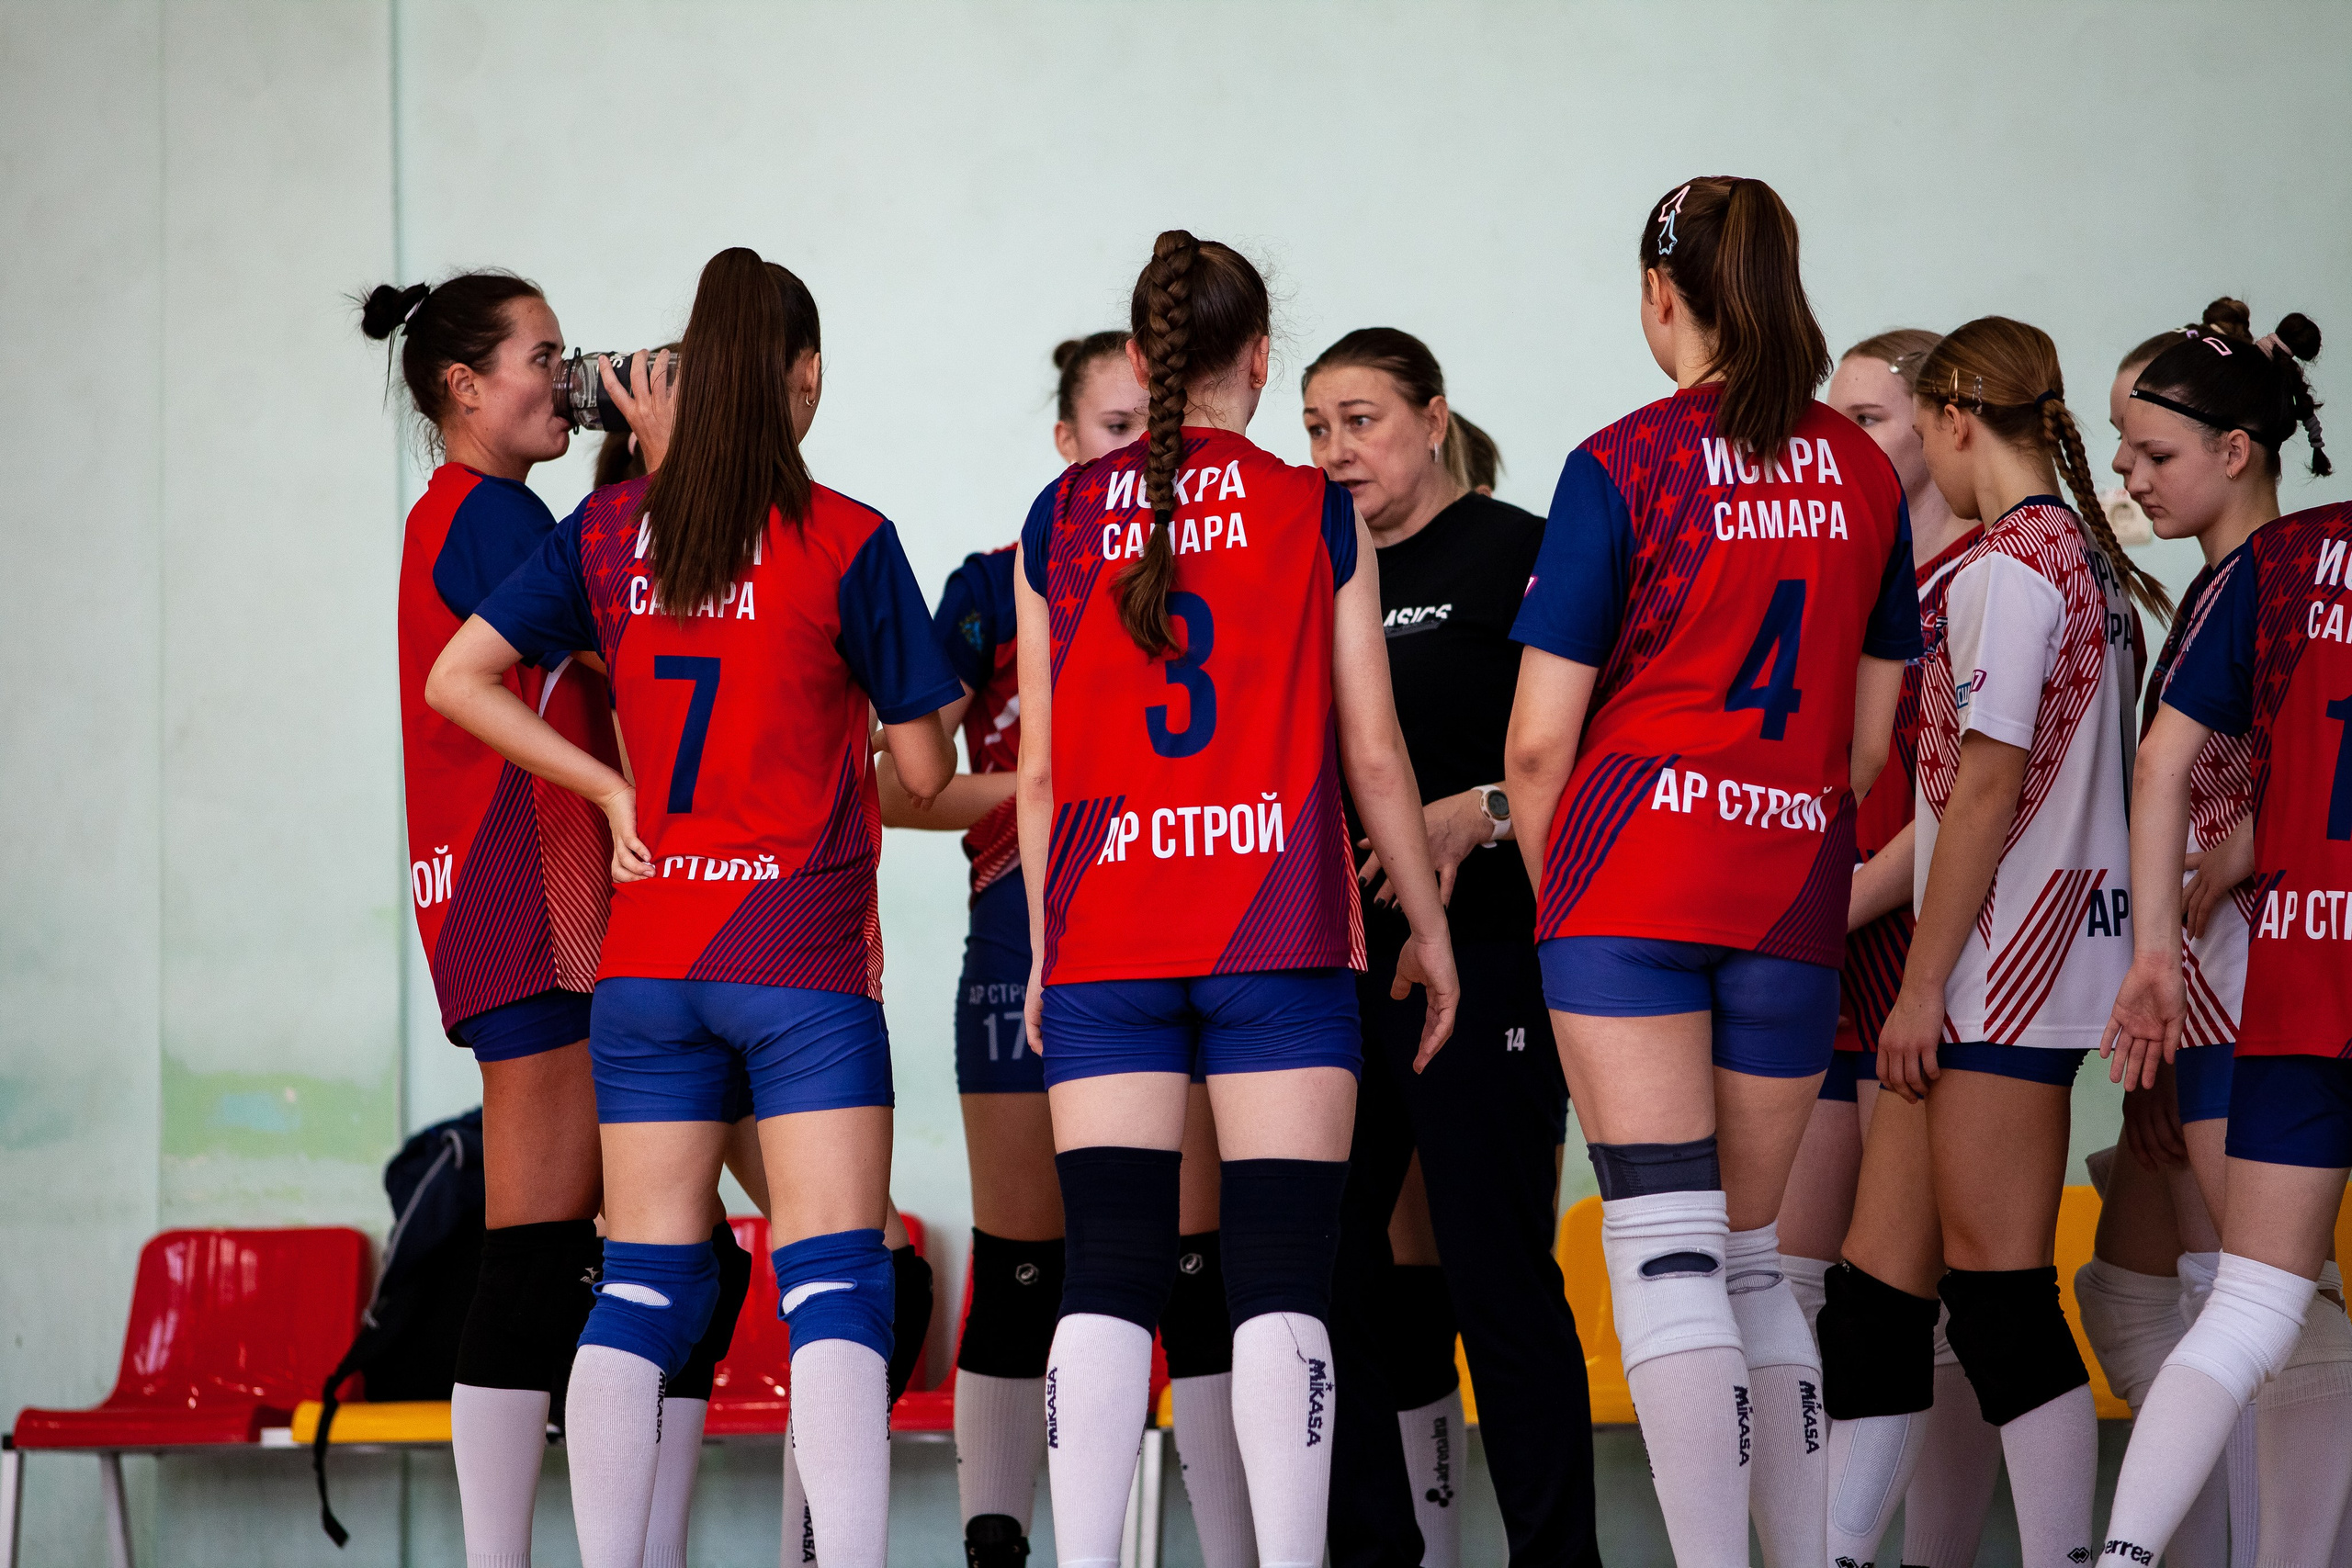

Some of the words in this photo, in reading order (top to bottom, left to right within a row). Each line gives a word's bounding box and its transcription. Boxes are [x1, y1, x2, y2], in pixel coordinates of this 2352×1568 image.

[1702, 437, 1843, 486] ИСКРА
[1714, 499, 1849, 541] САМАРА
[1145, 591, 1217, 758] 3
[1724, 579, 1806, 740] 4
[654, 656, 721, 814] 7
[1097, 812, 1139, 865] АР
[1152, 792, 1284, 860] СТРОЙ
[1651, 767, 1708, 813] АР
[1718, 779, 1833, 833] СТРОЙ
[2087, 888, 2130, 937] АР
[2258, 890, 2298, 939] АР
[983, 1011, 1027, 1061] 17
[1505, 1027, 1526, 1052] 14
[1047, 1366, 1058, 1449] MIKASA
[1307, 1359, 1327, 1447] MIKASA
[1734, 1385, 1751, 1467] MIKASA
[1799, 1381, 1820, 1454] MIKASA
